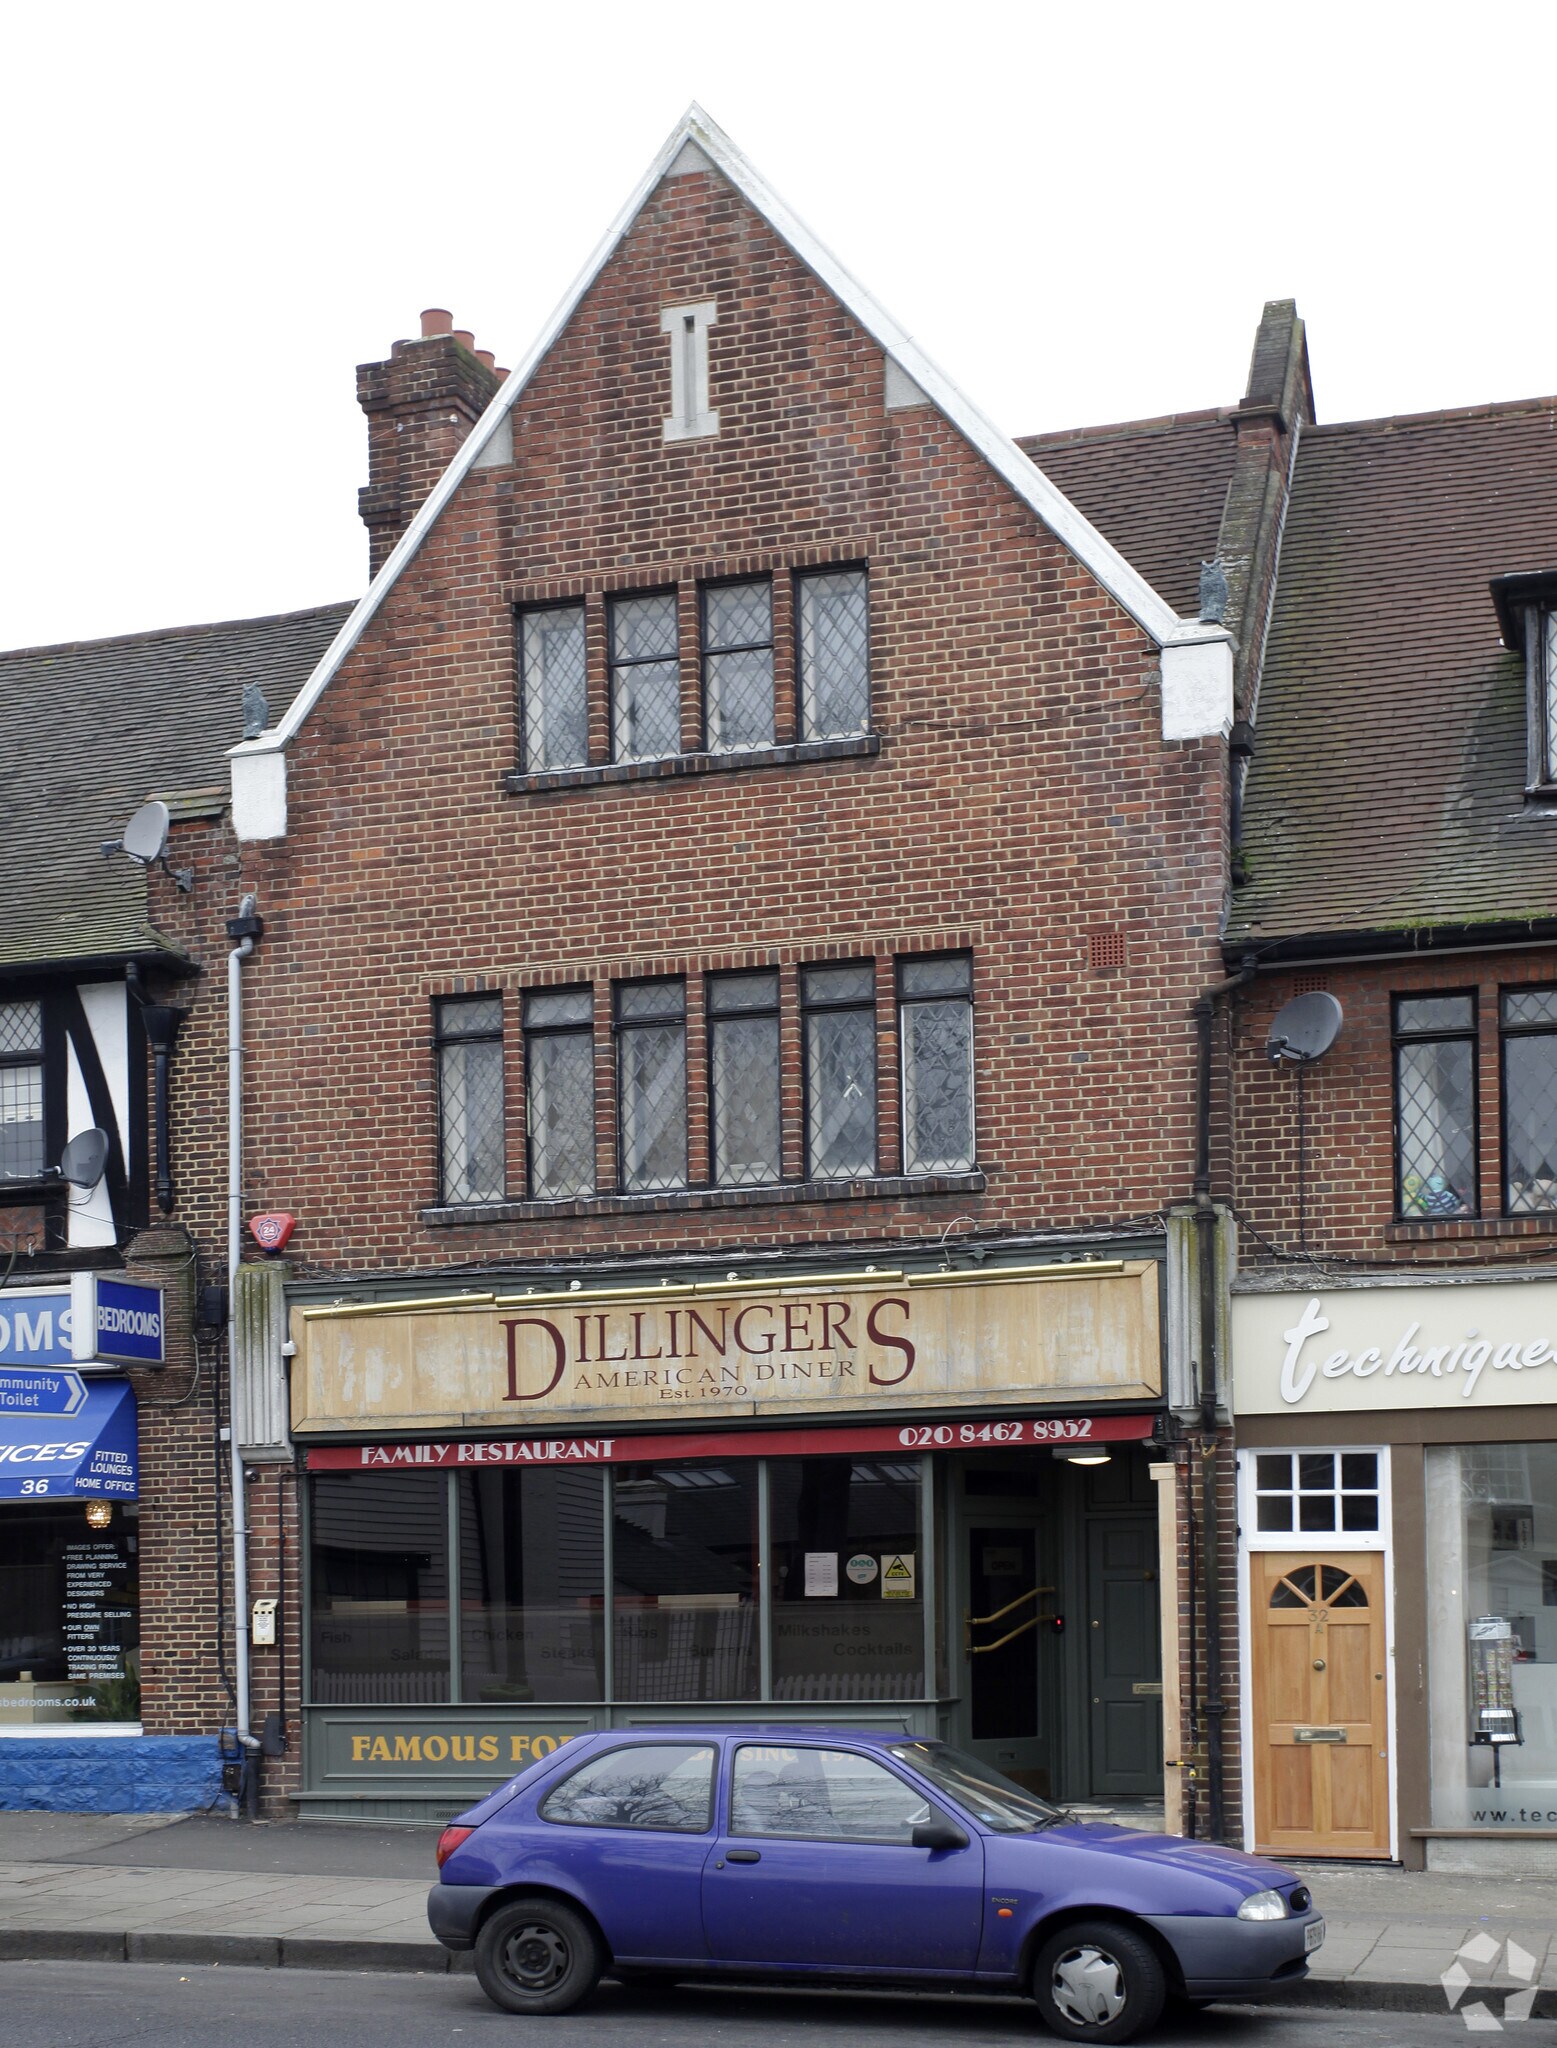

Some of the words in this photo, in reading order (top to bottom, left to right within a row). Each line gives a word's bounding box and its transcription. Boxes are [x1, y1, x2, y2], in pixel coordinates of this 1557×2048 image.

[97, 1305, 160, 1338] BEDROOMS
[499, 1298, 916, 1402] DILLINGERS
[1279, 1297, 1557, 1404] technique
[574, 1365, 741, 1390] AMERICAN
[756, 1361, 856, 1382] DINER
[0, 1377, 60, 1393] mmunity
[660, 1388, 695, 1400] Est.
[700, 1385, 748, 1398] 1970
[0, 1391, 39, 1406] Toilet
[899, 1426, 953, 1447] 020
[960, 1422, 1023, 1442] 8462
[1033, 1418, 1093, 1438] 8952
[0, 1441, 92, 1463] ICES
[95, 1450, 128, 1463] FITTED
[361, 1444, 449, 1465] FAMILY
[458, 1440, 615, 1461] RESTAURANT
[90, 1462, 133, 1476] LOUNGES
[20, 1479, 50, 1494] 36
[75, 1477, 102, 1489] HOME
[104, 1480, 136, 1492] OFFICE
[87, 1571, 105, 1579] VERY
[1307, 1609, 1329, 1623] 32
[83, 1624, 100, 1632] OWN
[472, 1628, 534, 1642] Chicken
[777, 1623, 871, 1636] Milkshakes
[321, 1631, 352, 1643] Fish
[390, 1647, 443, 1662] Sala
[540, 1646, 597, 1660] Steaks
[833, 1642, 913, 1656] Cocktails
[351, 1735, 499, 1761] FAMOUS
